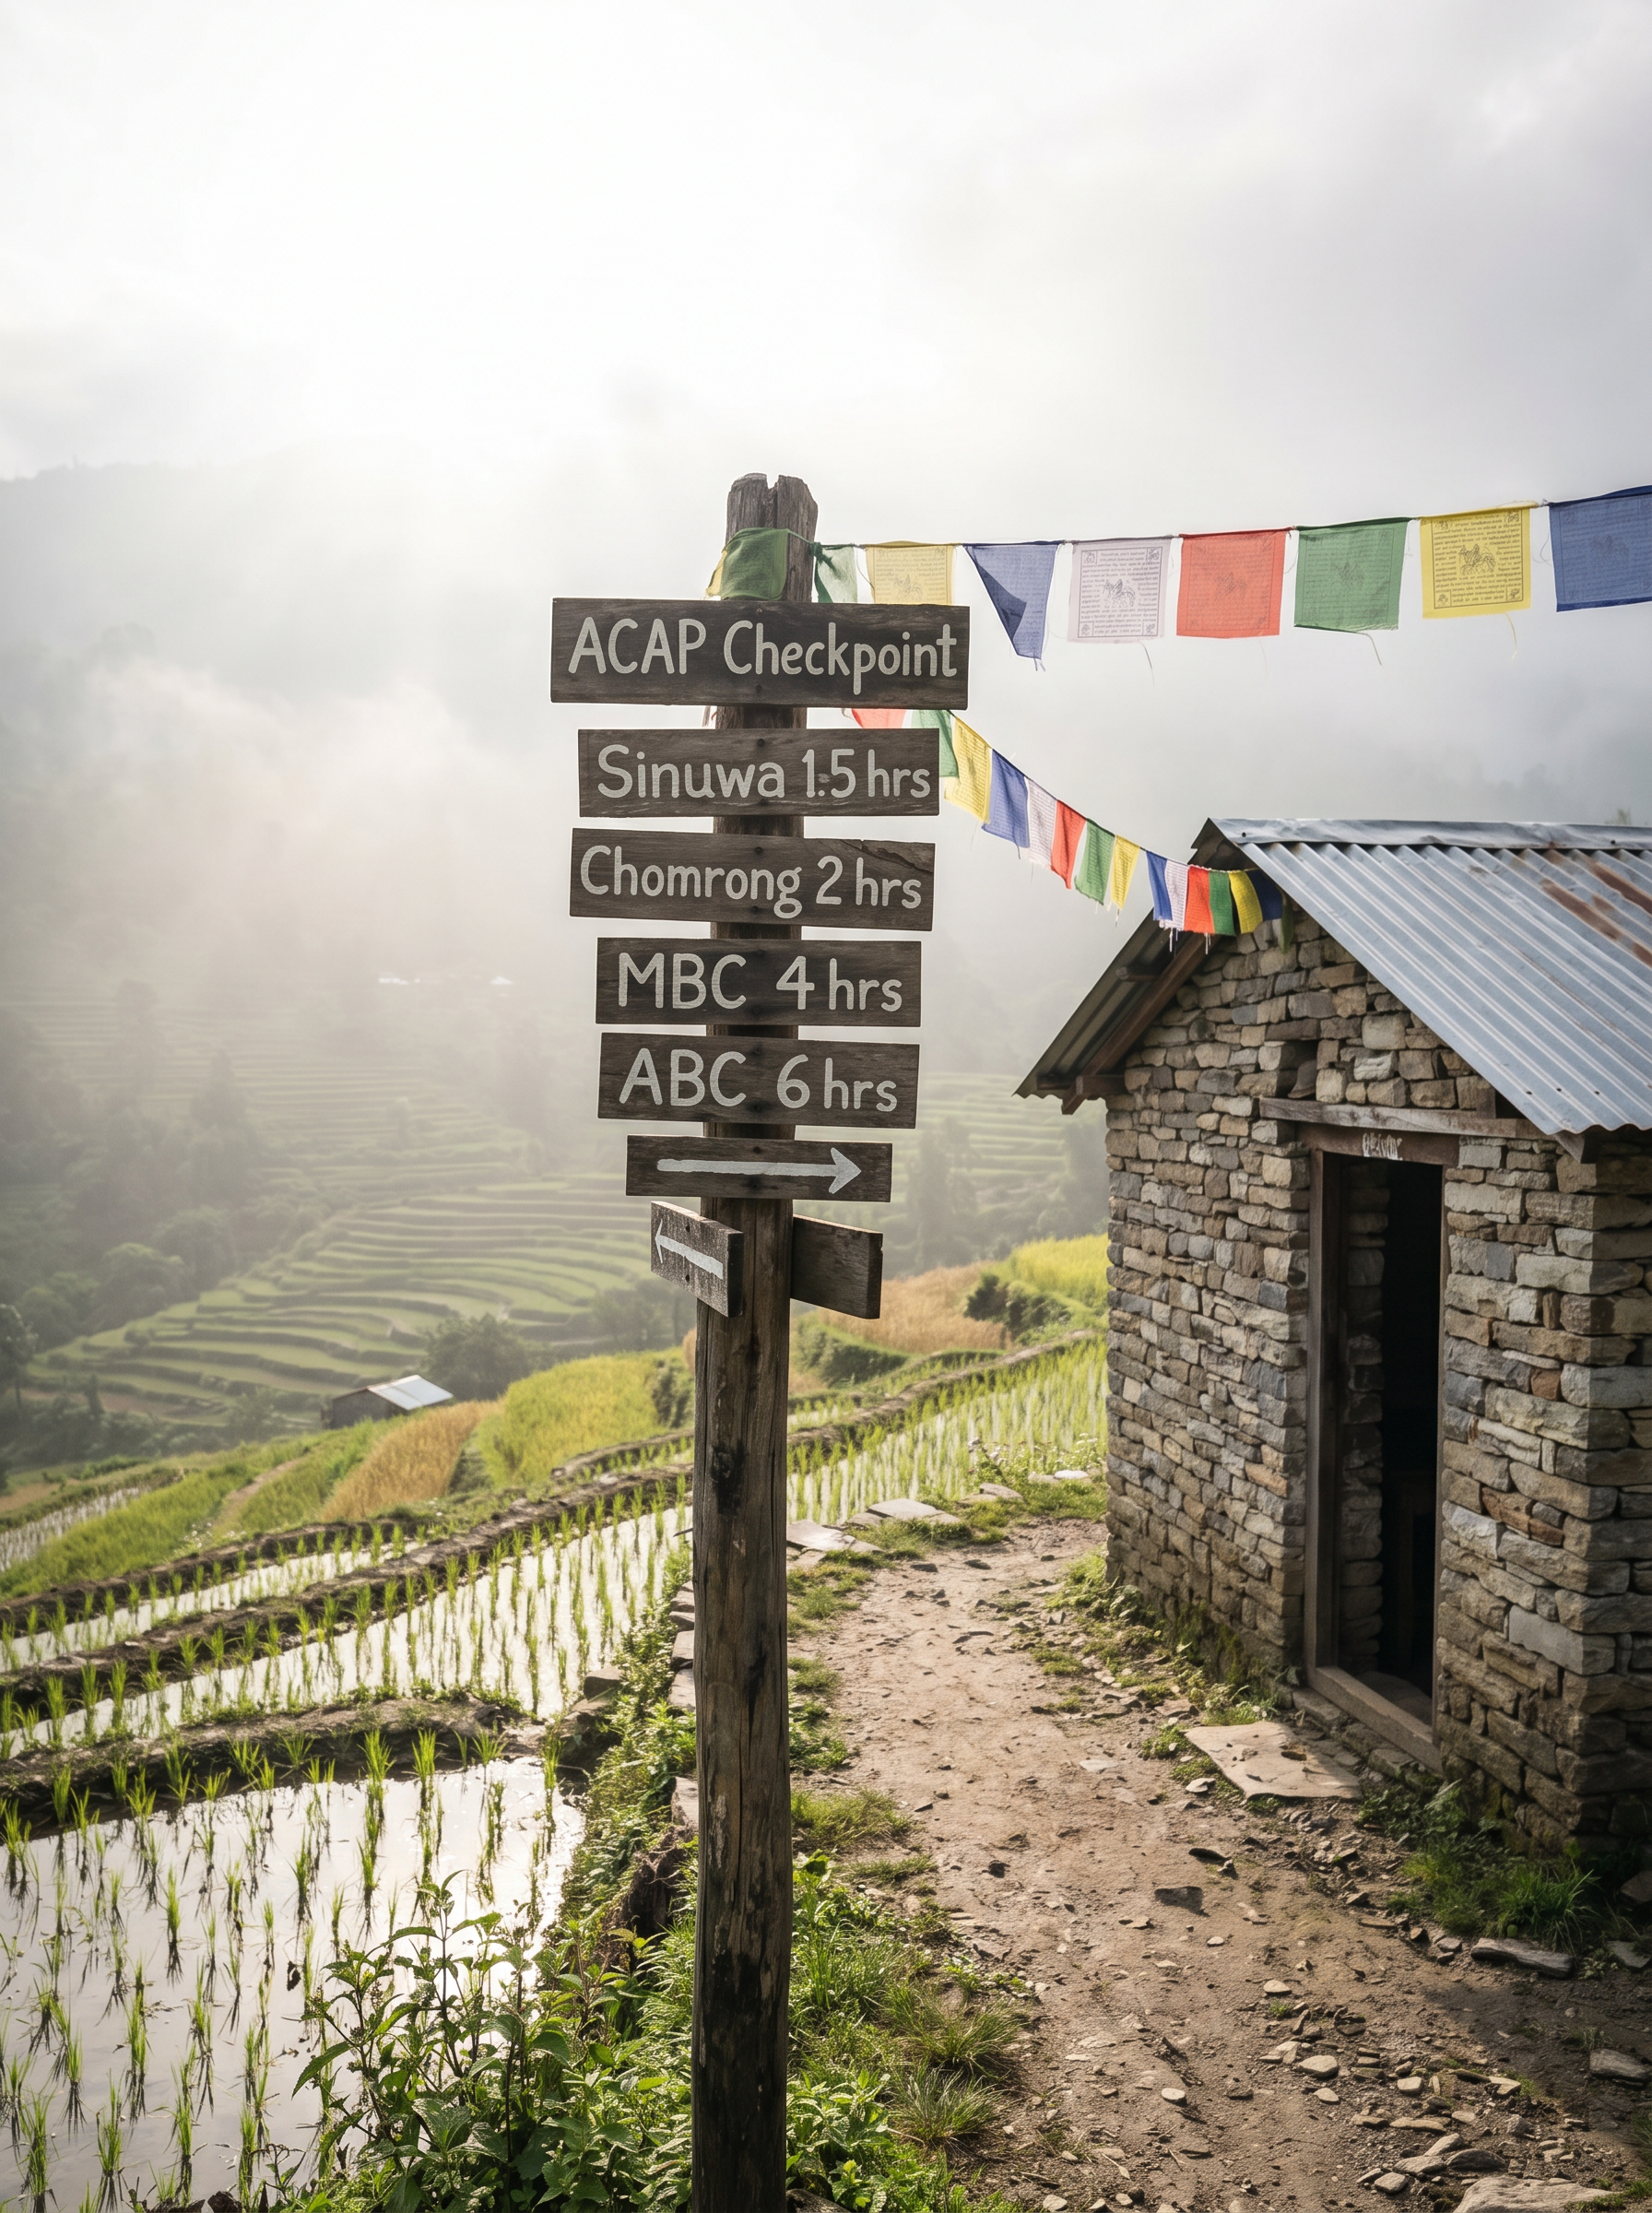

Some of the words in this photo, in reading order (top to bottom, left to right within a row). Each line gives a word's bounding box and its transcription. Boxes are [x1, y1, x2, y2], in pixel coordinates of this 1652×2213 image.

[569, 617, 706, 674] ACAP
[724, 621, 957, 694] Checkpoint
[598, 744, 785, 798] Sinuwa
[802, 749, 856, 798] 1.5
[868, 750, 930, 798] hrs
[580, 846, 802, 918] Chomrong
[816, 856, 843, 905] 2
[856, 858, 921, 908] hrs
[619, 953, 746, 1009] MBC
[776, 956, 814, 1010] 4
[829, 958, 902, 1012] hrs
[620, 1048, 746, 1106] ABC
[777, 1055, 809, 1108] 6
[824, 1058, 897, 1111] hrs
